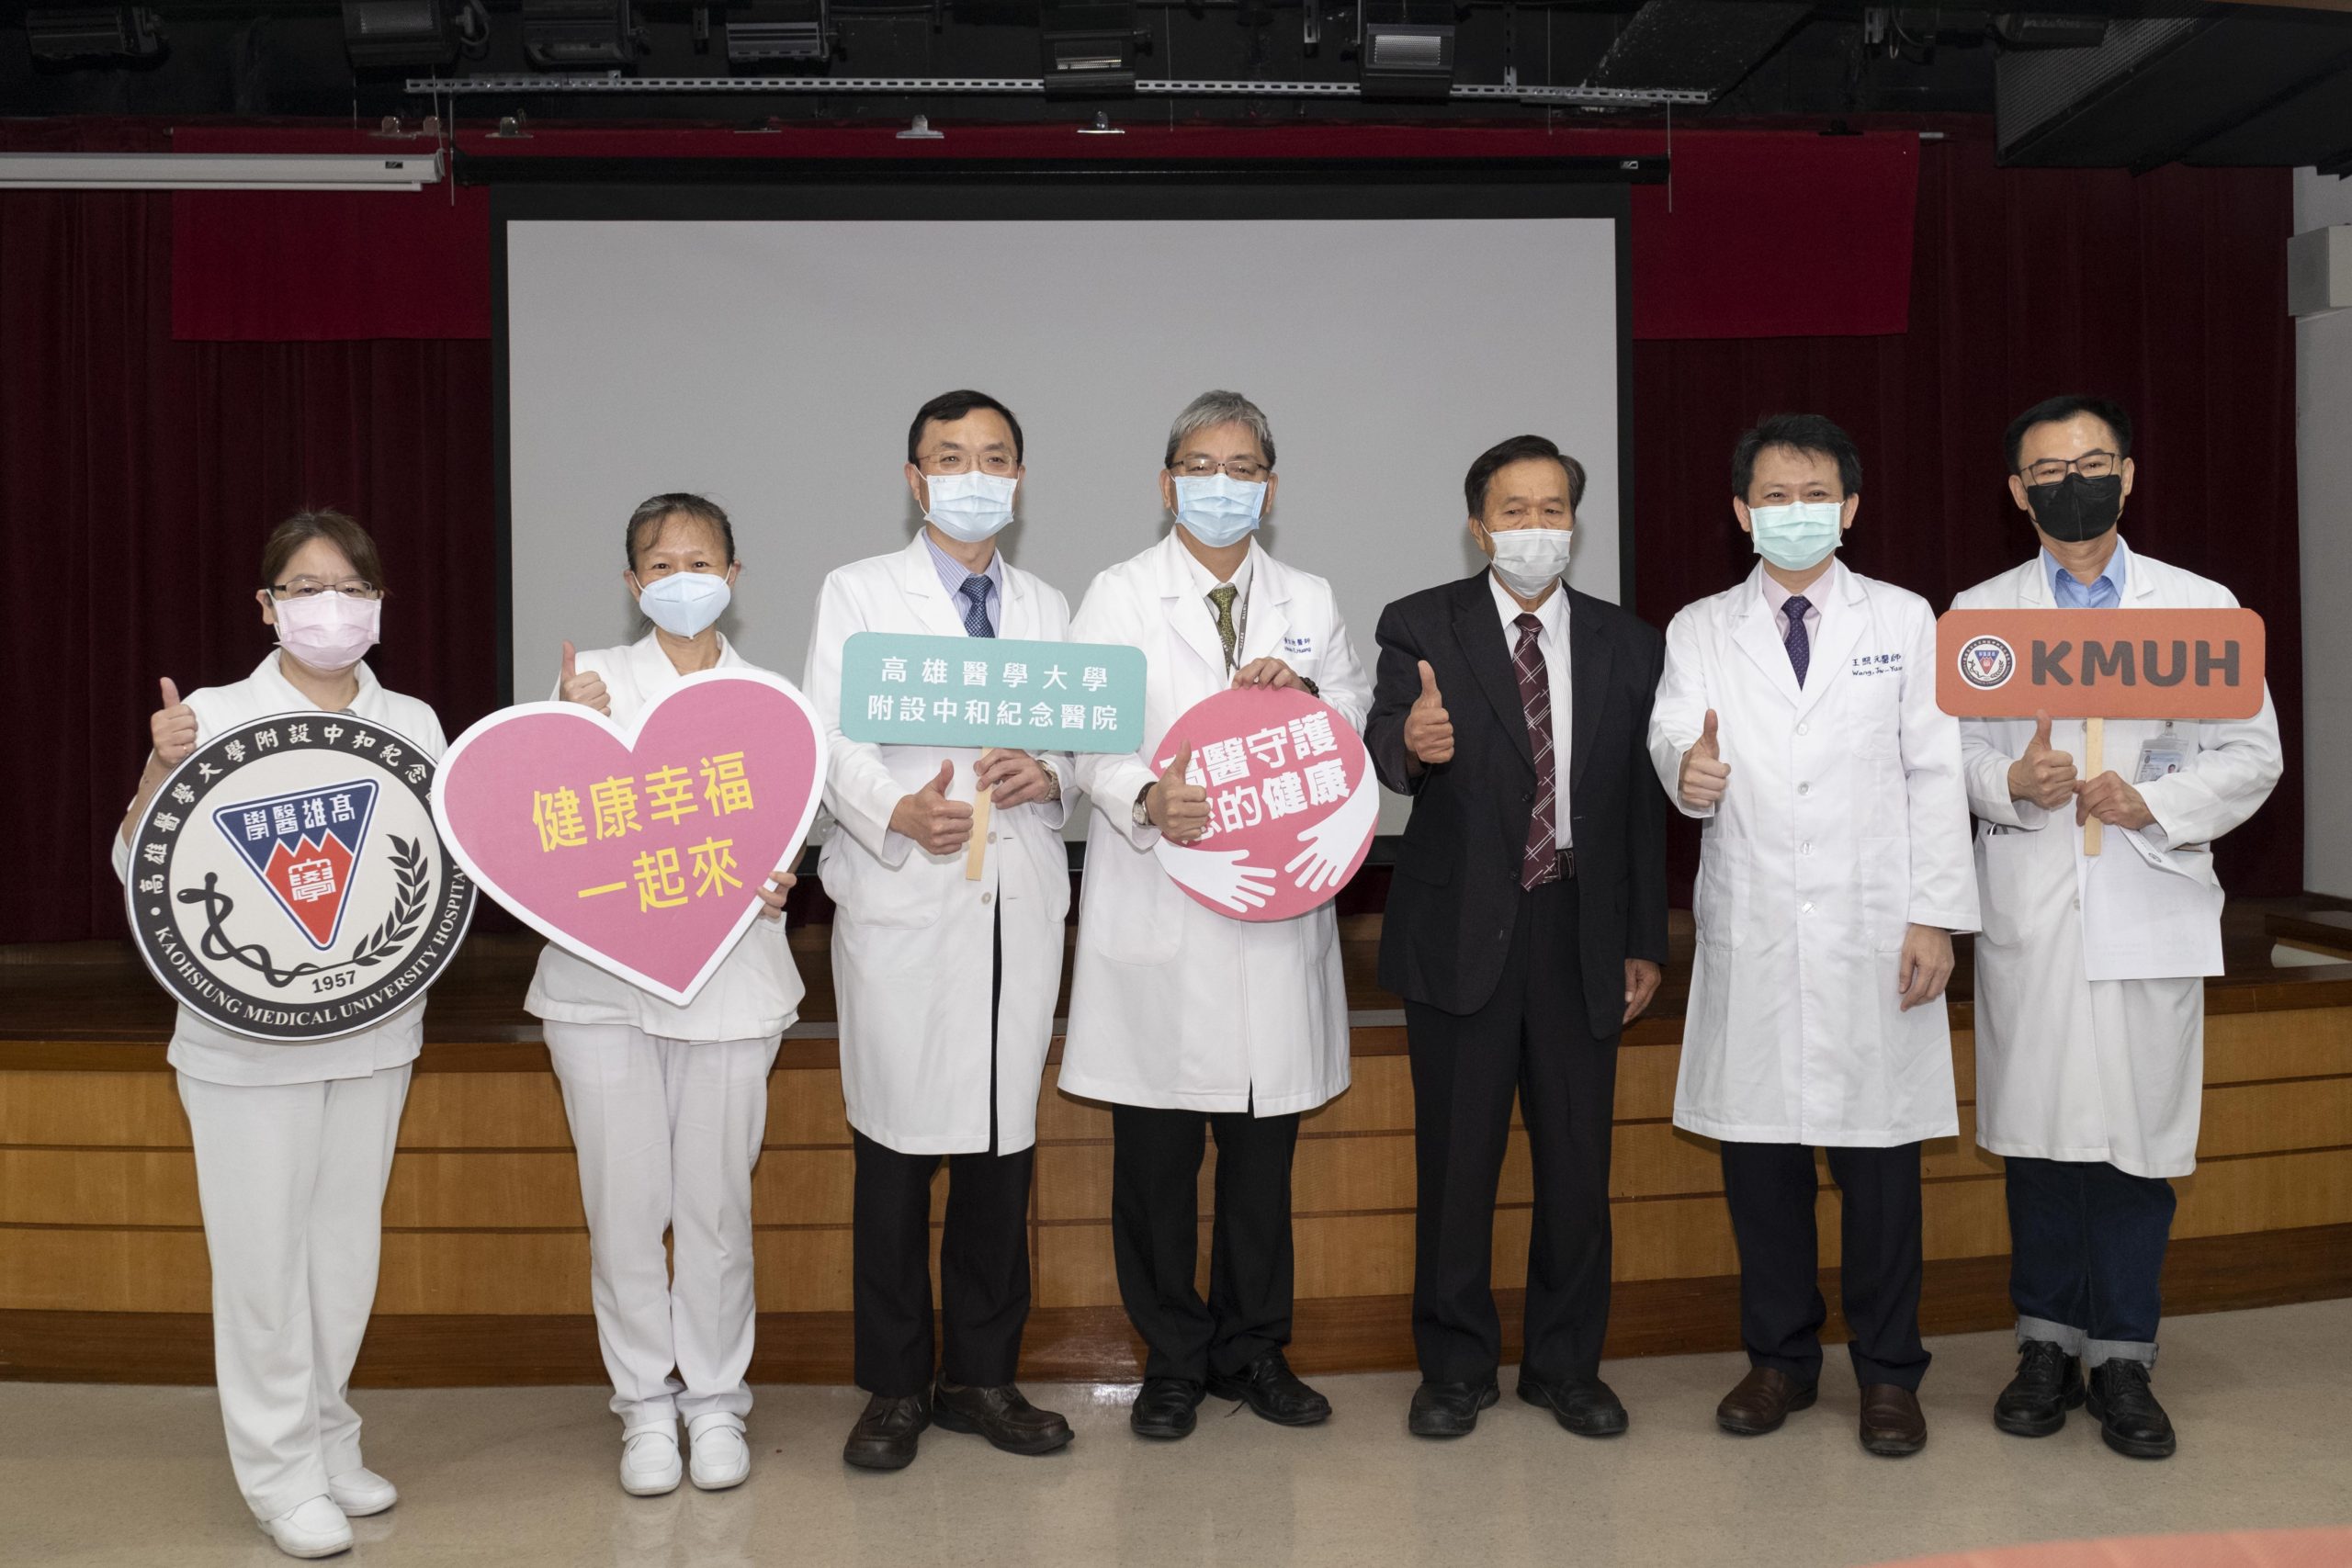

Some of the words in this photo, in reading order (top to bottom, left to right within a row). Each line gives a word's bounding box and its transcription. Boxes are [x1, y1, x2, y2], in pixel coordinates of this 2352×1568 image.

[880, 656, 1108, 693] 高雄醫學大學
[2031, 640, 2240, 687] KMUH
[867, 694, 1118, 731] 附設中和紀念醫院
[140, 723, 434, 896] 高雄醫學大學附設中和紀念
[531, 750, 754, 853] 健康幸福
[577, 837, 744, 913] 一起來
[154, 926, 243, 1014] KAOHSIUNG
[243, 1005, 339, 1026] MEDICAL
[339, 946, 439, 1019] UNIVERSITY
[311, 970, 356, 994] 1957
